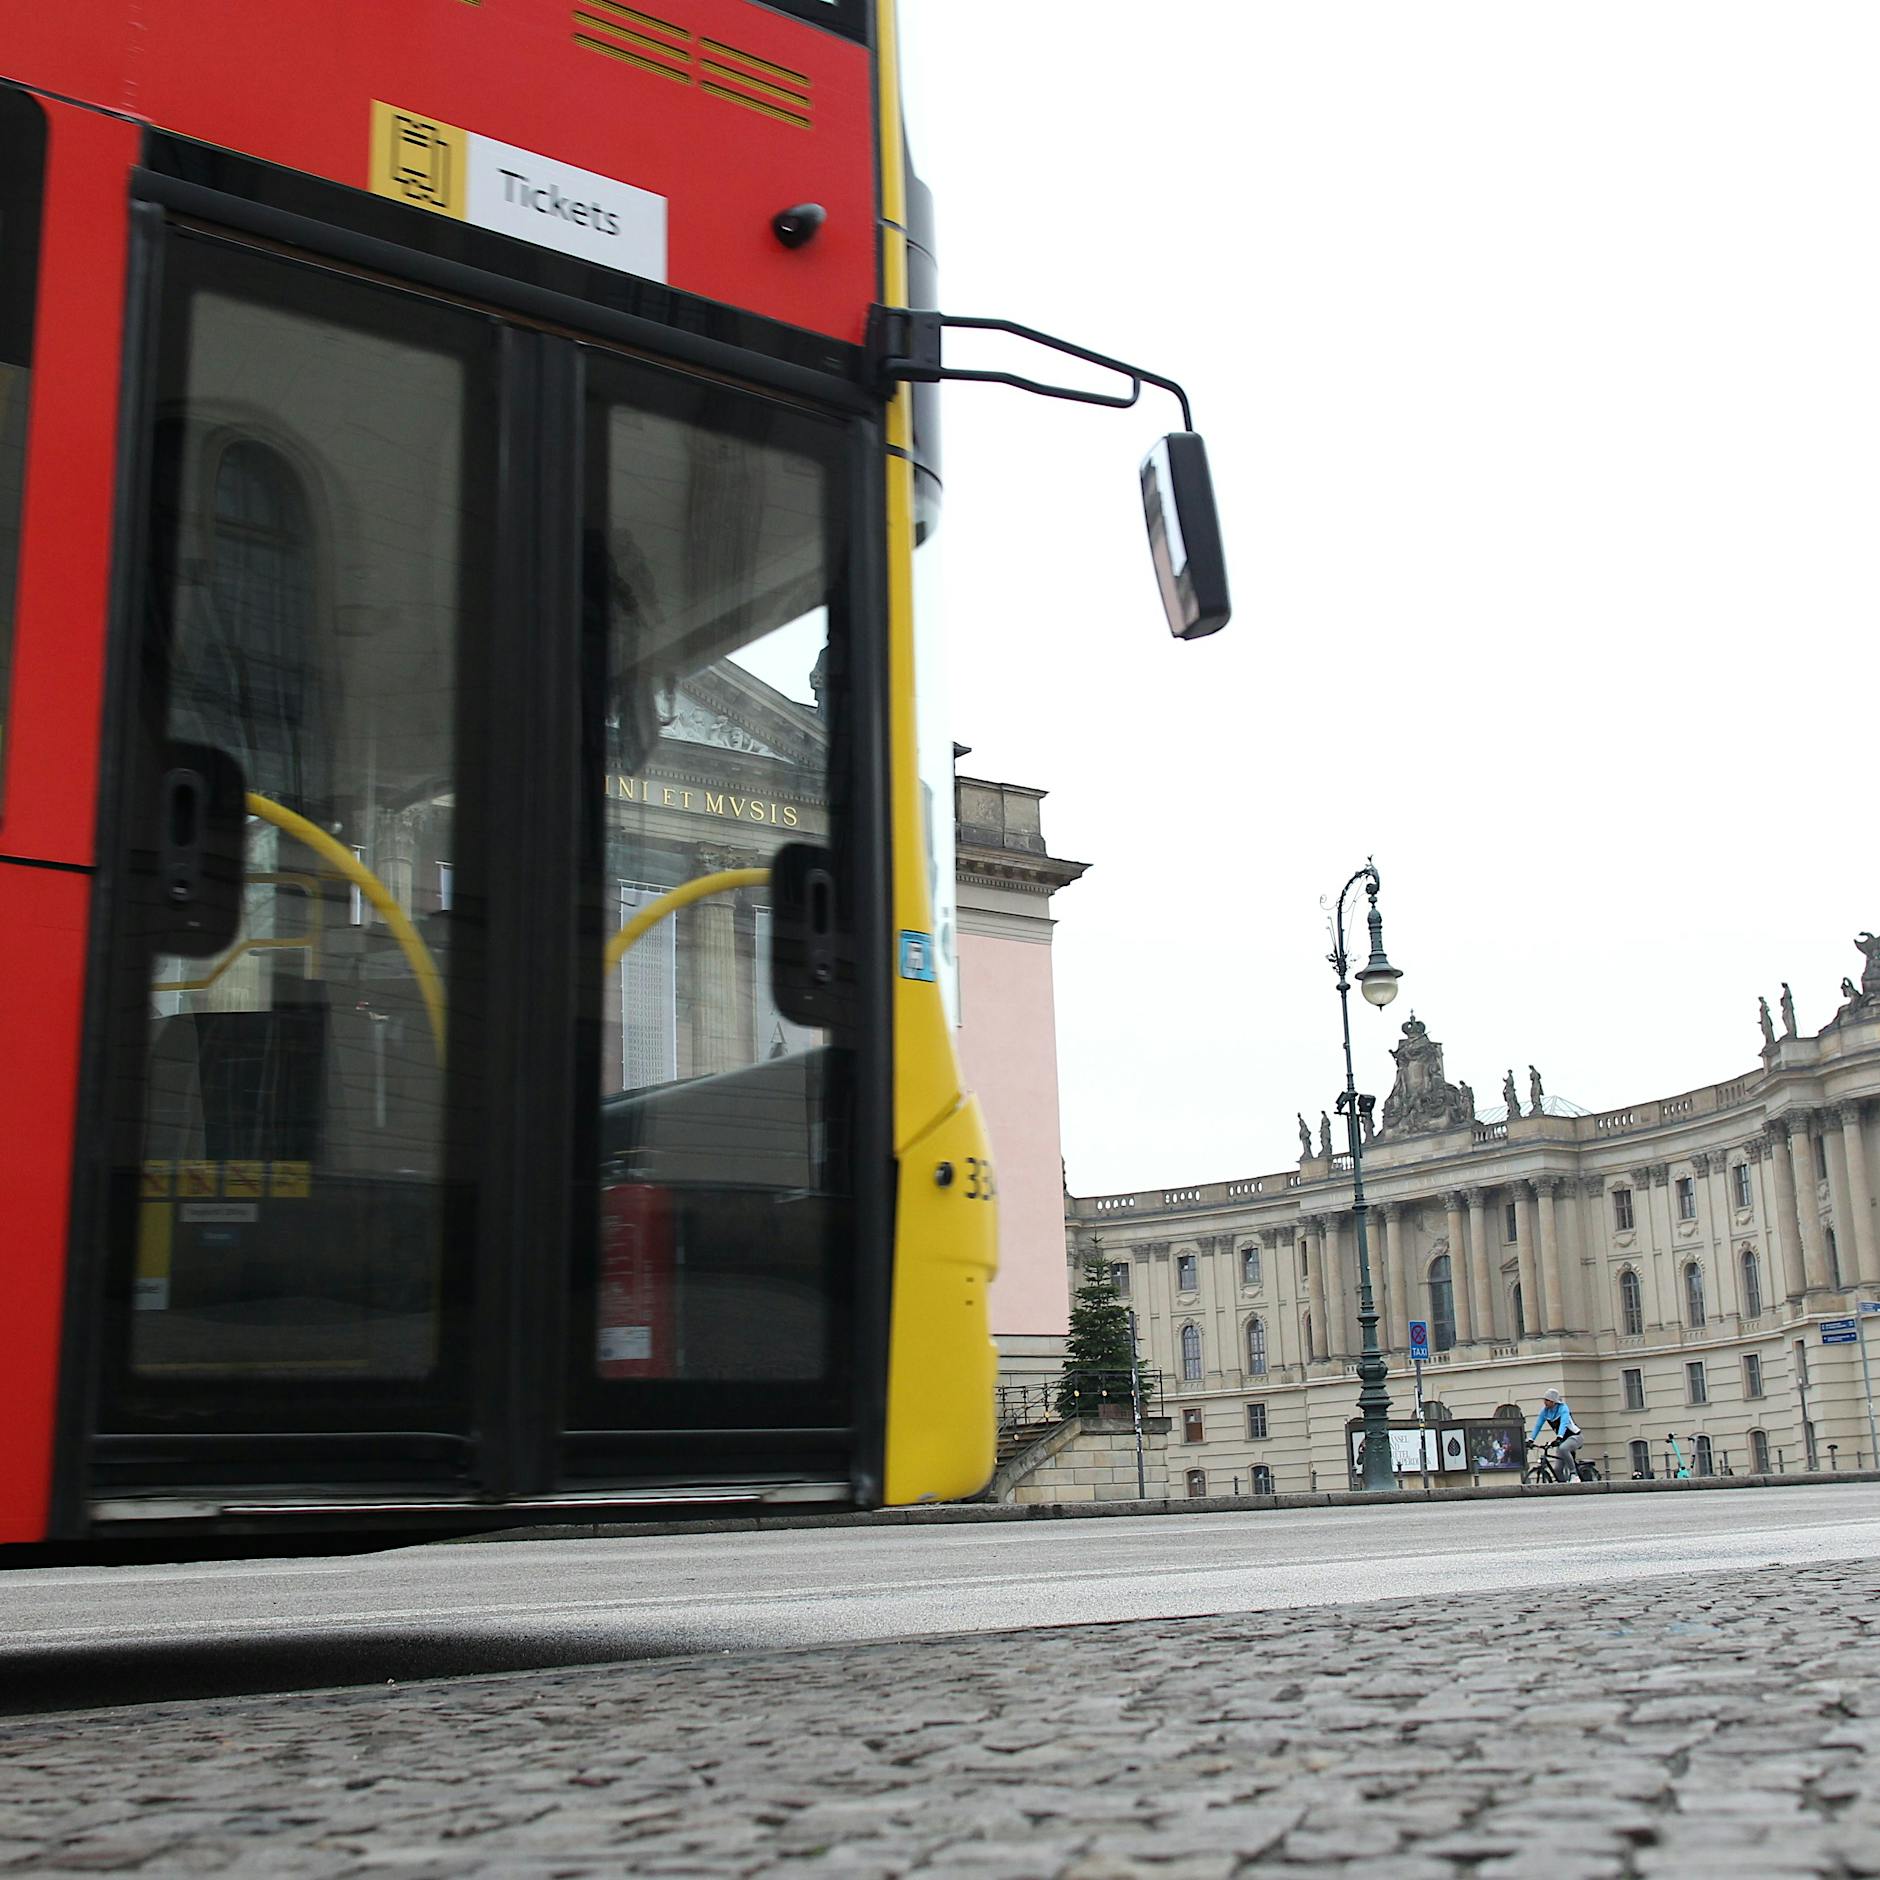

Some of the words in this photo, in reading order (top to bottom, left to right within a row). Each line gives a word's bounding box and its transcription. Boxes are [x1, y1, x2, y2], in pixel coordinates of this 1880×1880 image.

[497, 168, 621, 236] Tickets
[663, 787, 694, 809] ET
[705, 791, 798, 827] MVSIS
[1412, 1347, 1428, 1358] TAXI
